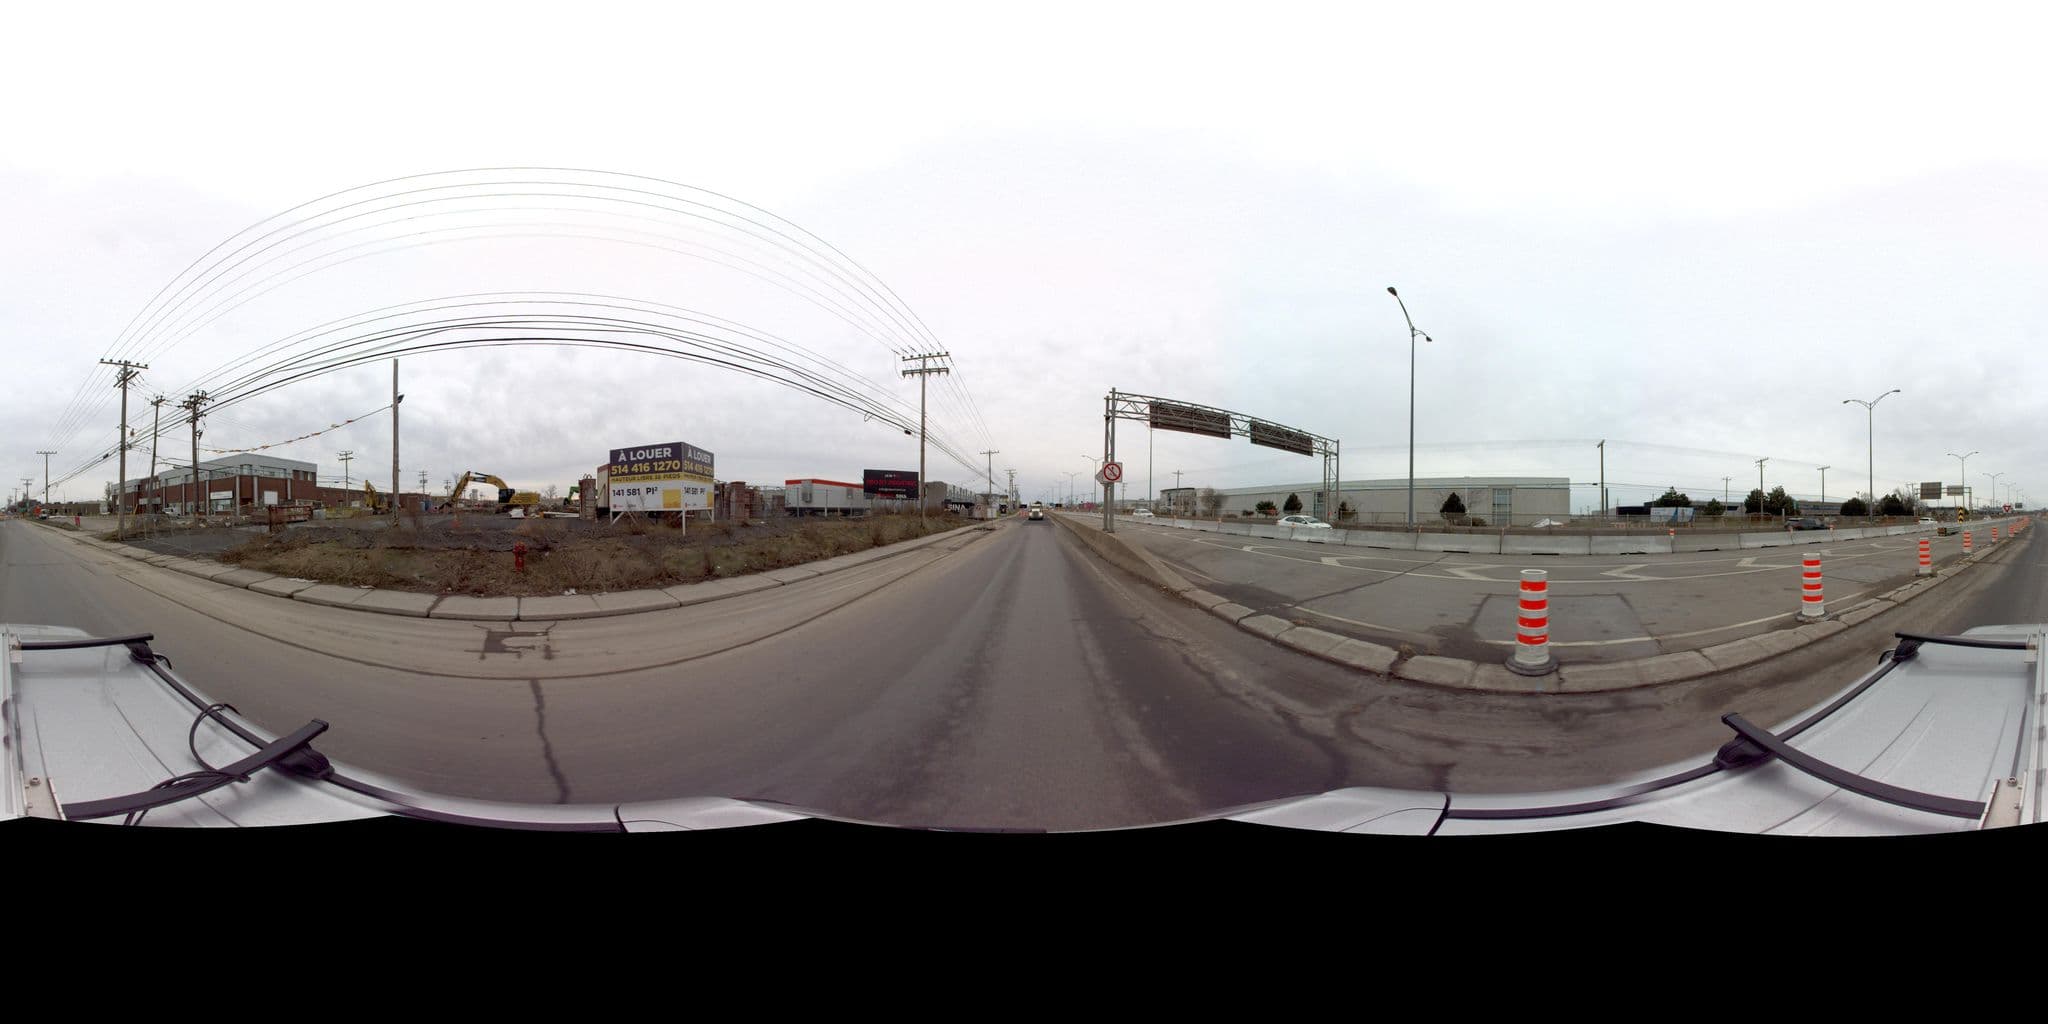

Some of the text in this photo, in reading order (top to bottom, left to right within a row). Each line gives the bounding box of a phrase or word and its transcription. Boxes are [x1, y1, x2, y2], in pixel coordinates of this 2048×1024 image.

[618, 447, 672, 462] À LOUER
[693, 450, 711, 464] LOUER
[611, 460, 680, 475] 514 416 1270
[612, 489, 625, 497] 141
[626, 488, 641, 496] 581
